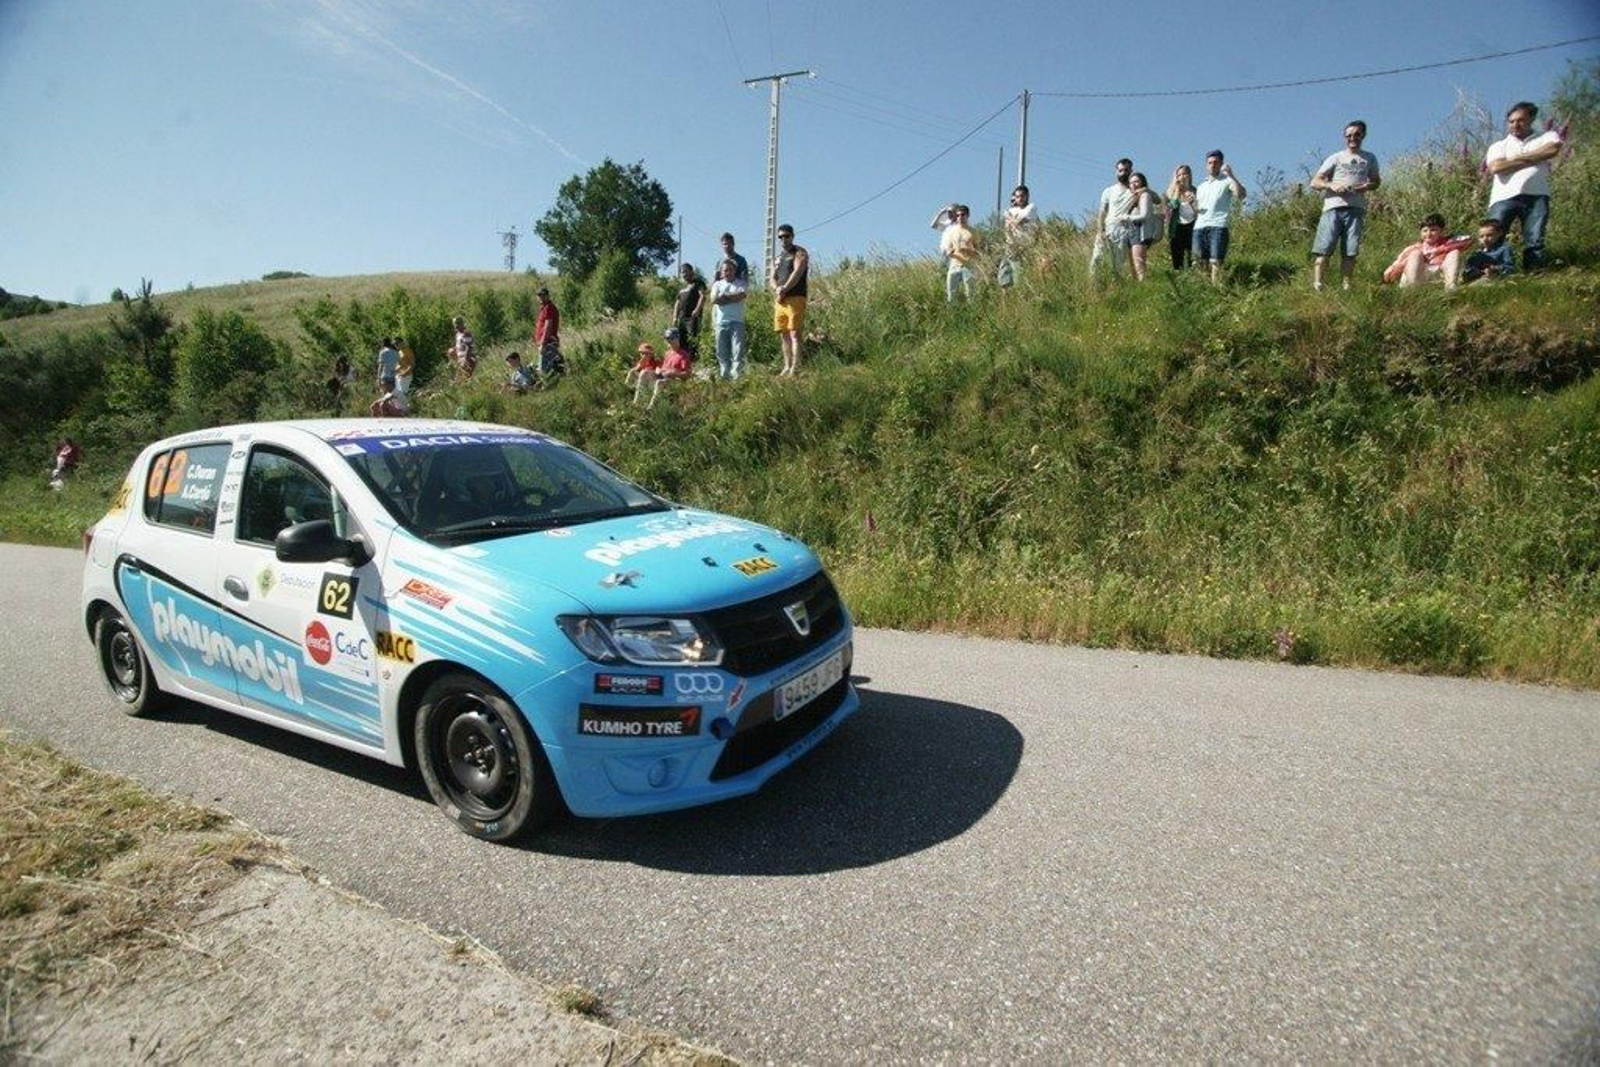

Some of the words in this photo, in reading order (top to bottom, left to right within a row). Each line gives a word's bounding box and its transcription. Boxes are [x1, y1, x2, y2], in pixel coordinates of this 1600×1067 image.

[380, 435, 482, 449] DACIA
[323, 579, 351, 613] 62
[152, 595, 304, 706] playmobil
[335, 631, 369, 660] CdeC
[376, 631, 415, 664] RACC
[583, 719, 642, 736] KUMHO
[646, 721, 683, 735] TYRE
